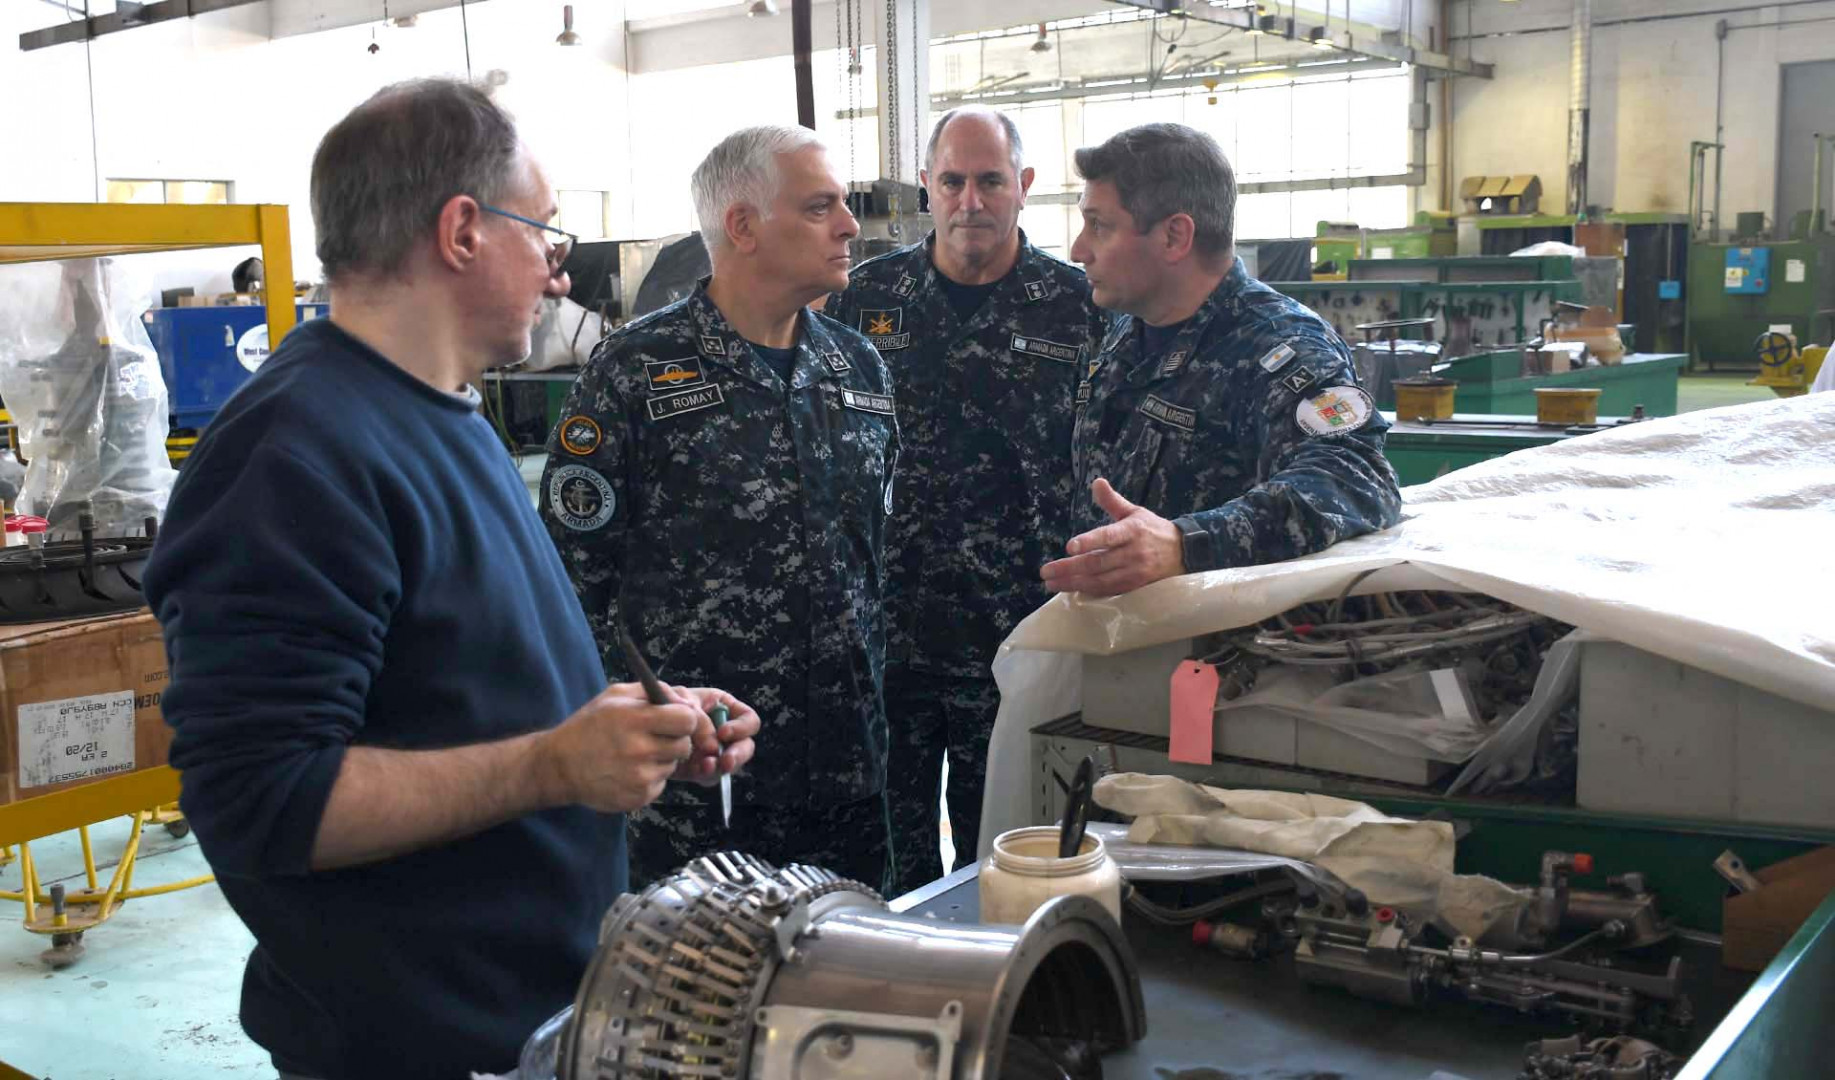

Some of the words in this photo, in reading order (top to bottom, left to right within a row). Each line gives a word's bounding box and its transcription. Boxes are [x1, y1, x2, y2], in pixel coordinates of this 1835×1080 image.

[656, 403, 666, 414] J.
[673, 391, 714, 408] ROMAY
[560, 512, 604, 528] ARMADA
[65, 741, 98, 756] 12/20
